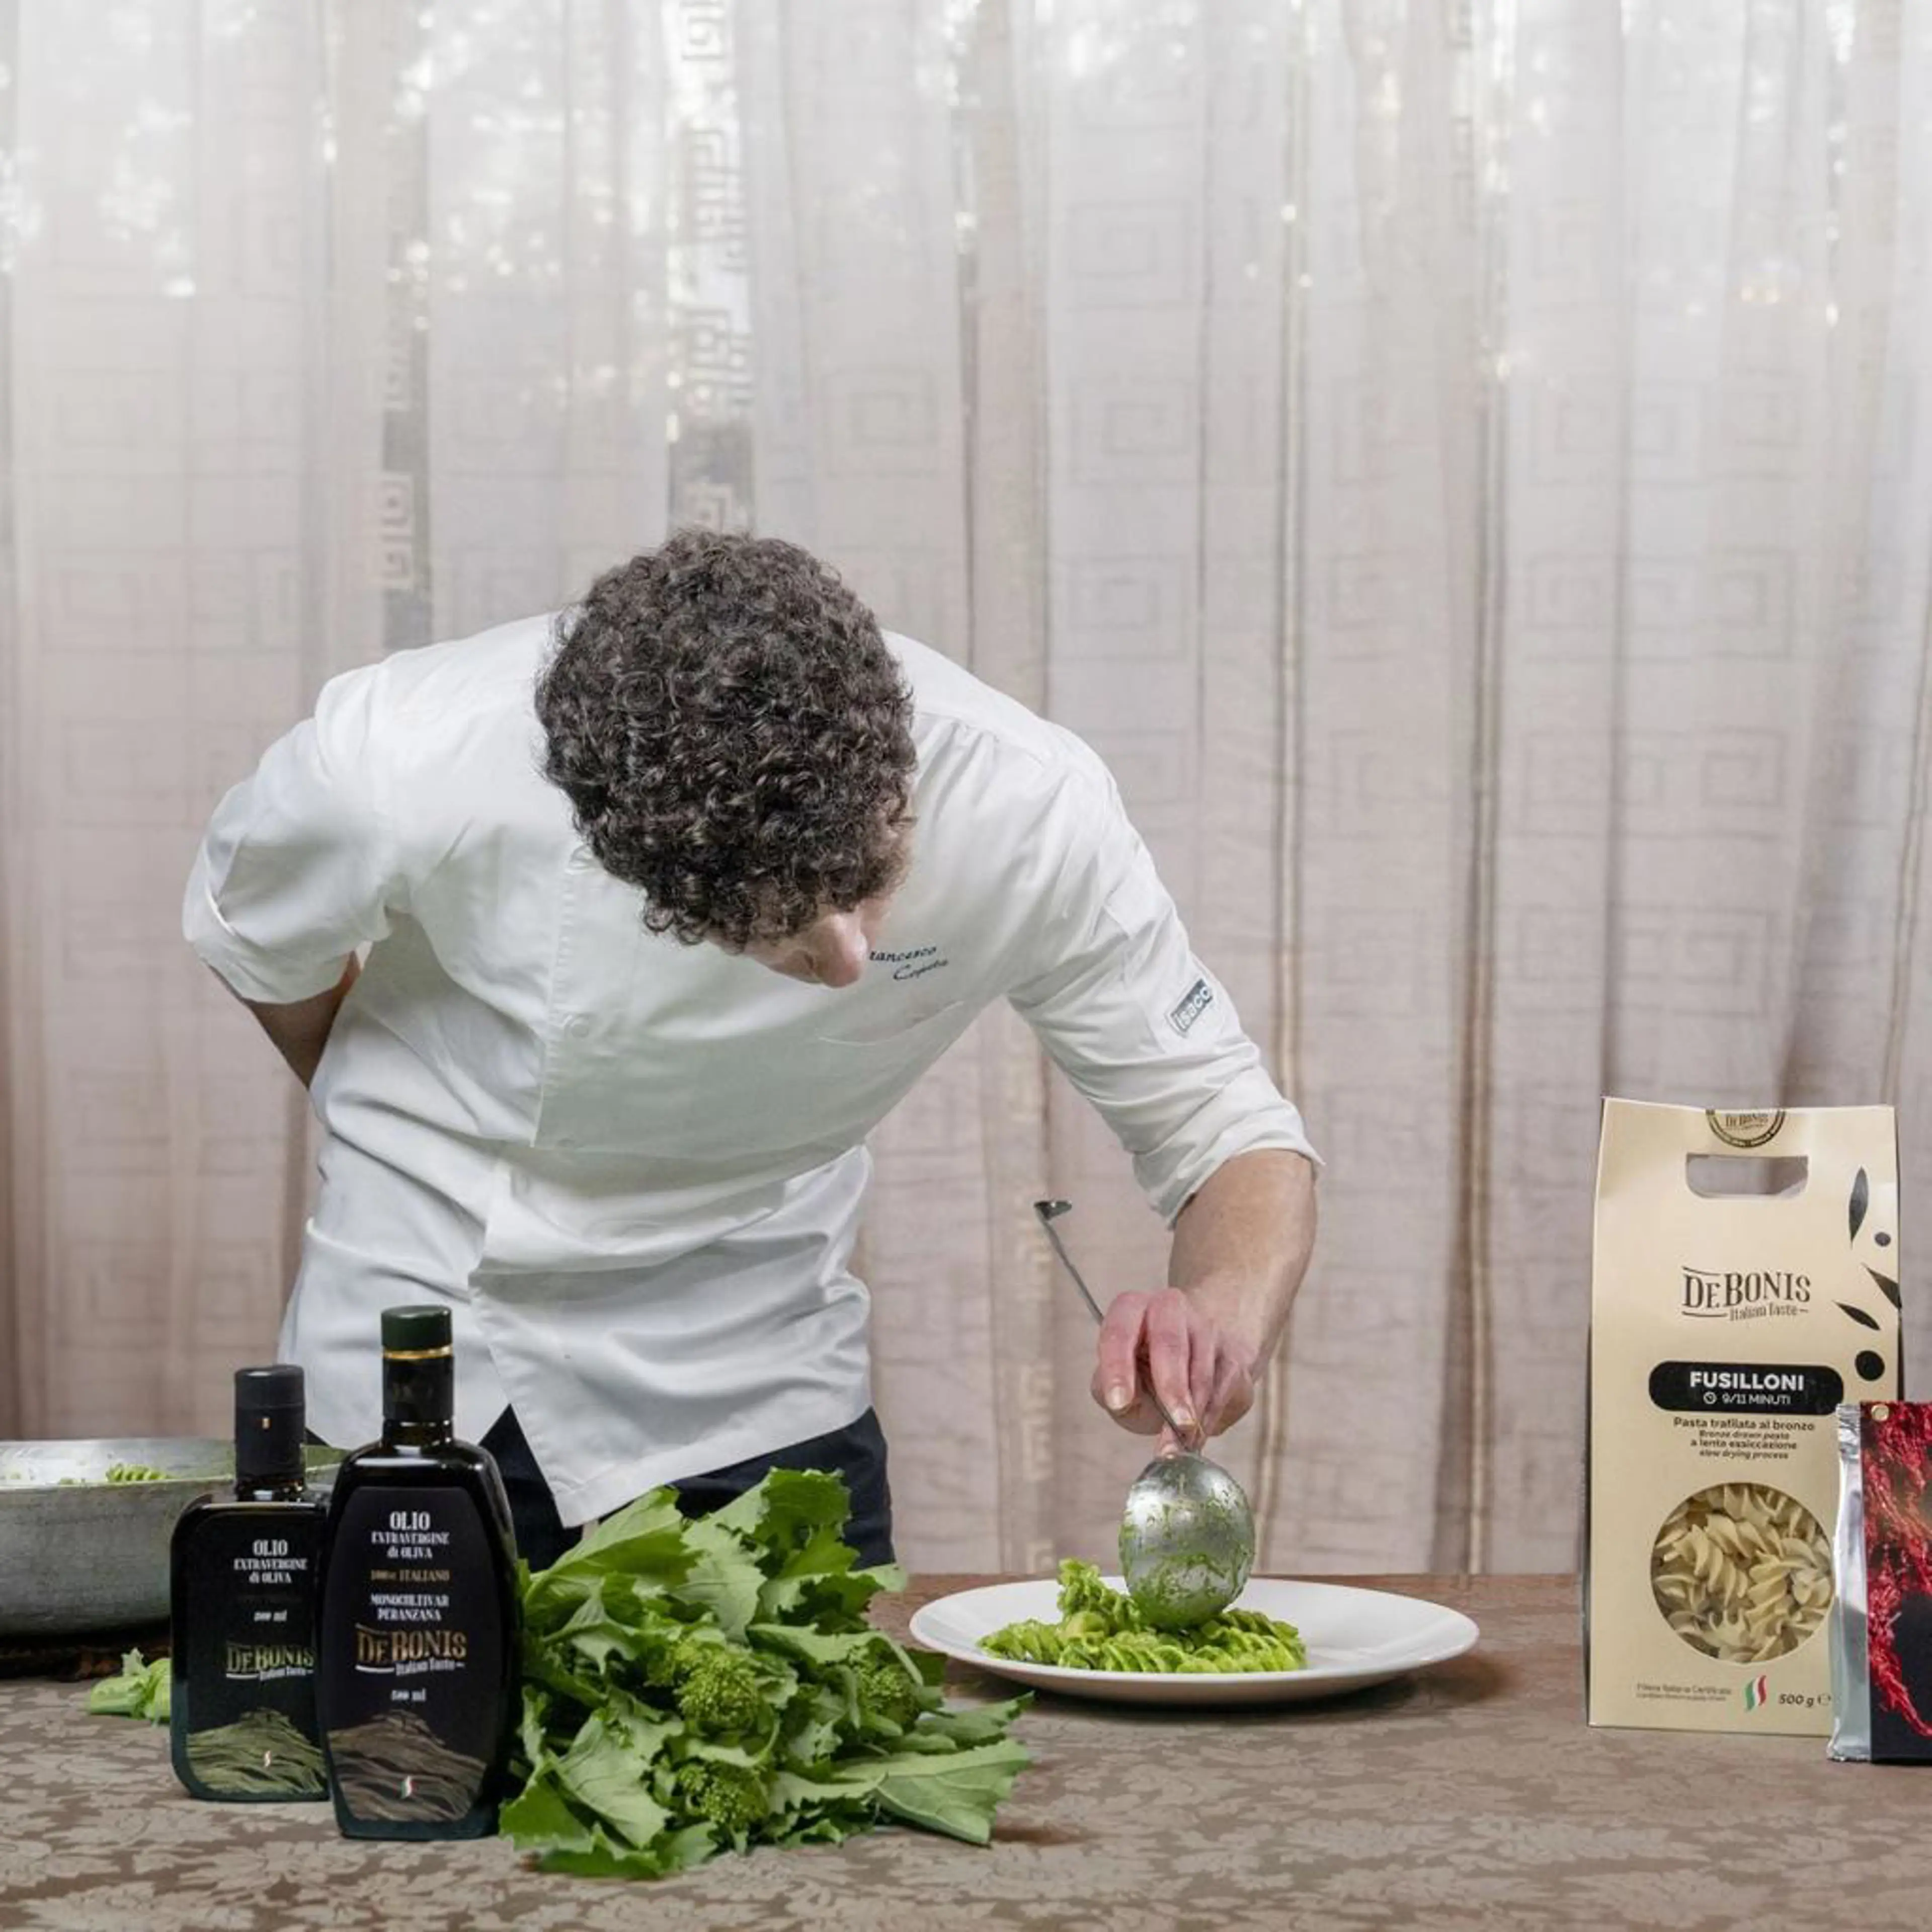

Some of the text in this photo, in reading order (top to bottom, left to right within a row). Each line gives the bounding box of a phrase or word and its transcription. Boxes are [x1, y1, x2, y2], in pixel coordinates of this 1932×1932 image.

[1689, 1371, 1804, 1391] FUSILLONI
[1722, 1392, 1791, 1405] 9/11 MINUTI
[1673, 1417, 1815, 1430] Pasta trafilata al bronzo
[389, 1511, 430, 1531] OLIO
[253, 1539, 288, 1557] OLIO
[400, 1547, 433, 1559] OLIVA
[261, 1571, 292, 1583] OLIVA
[399, 1570, 450, 1582] ITALIANO
[1779, 1693, 1815, 1708] 500 g
